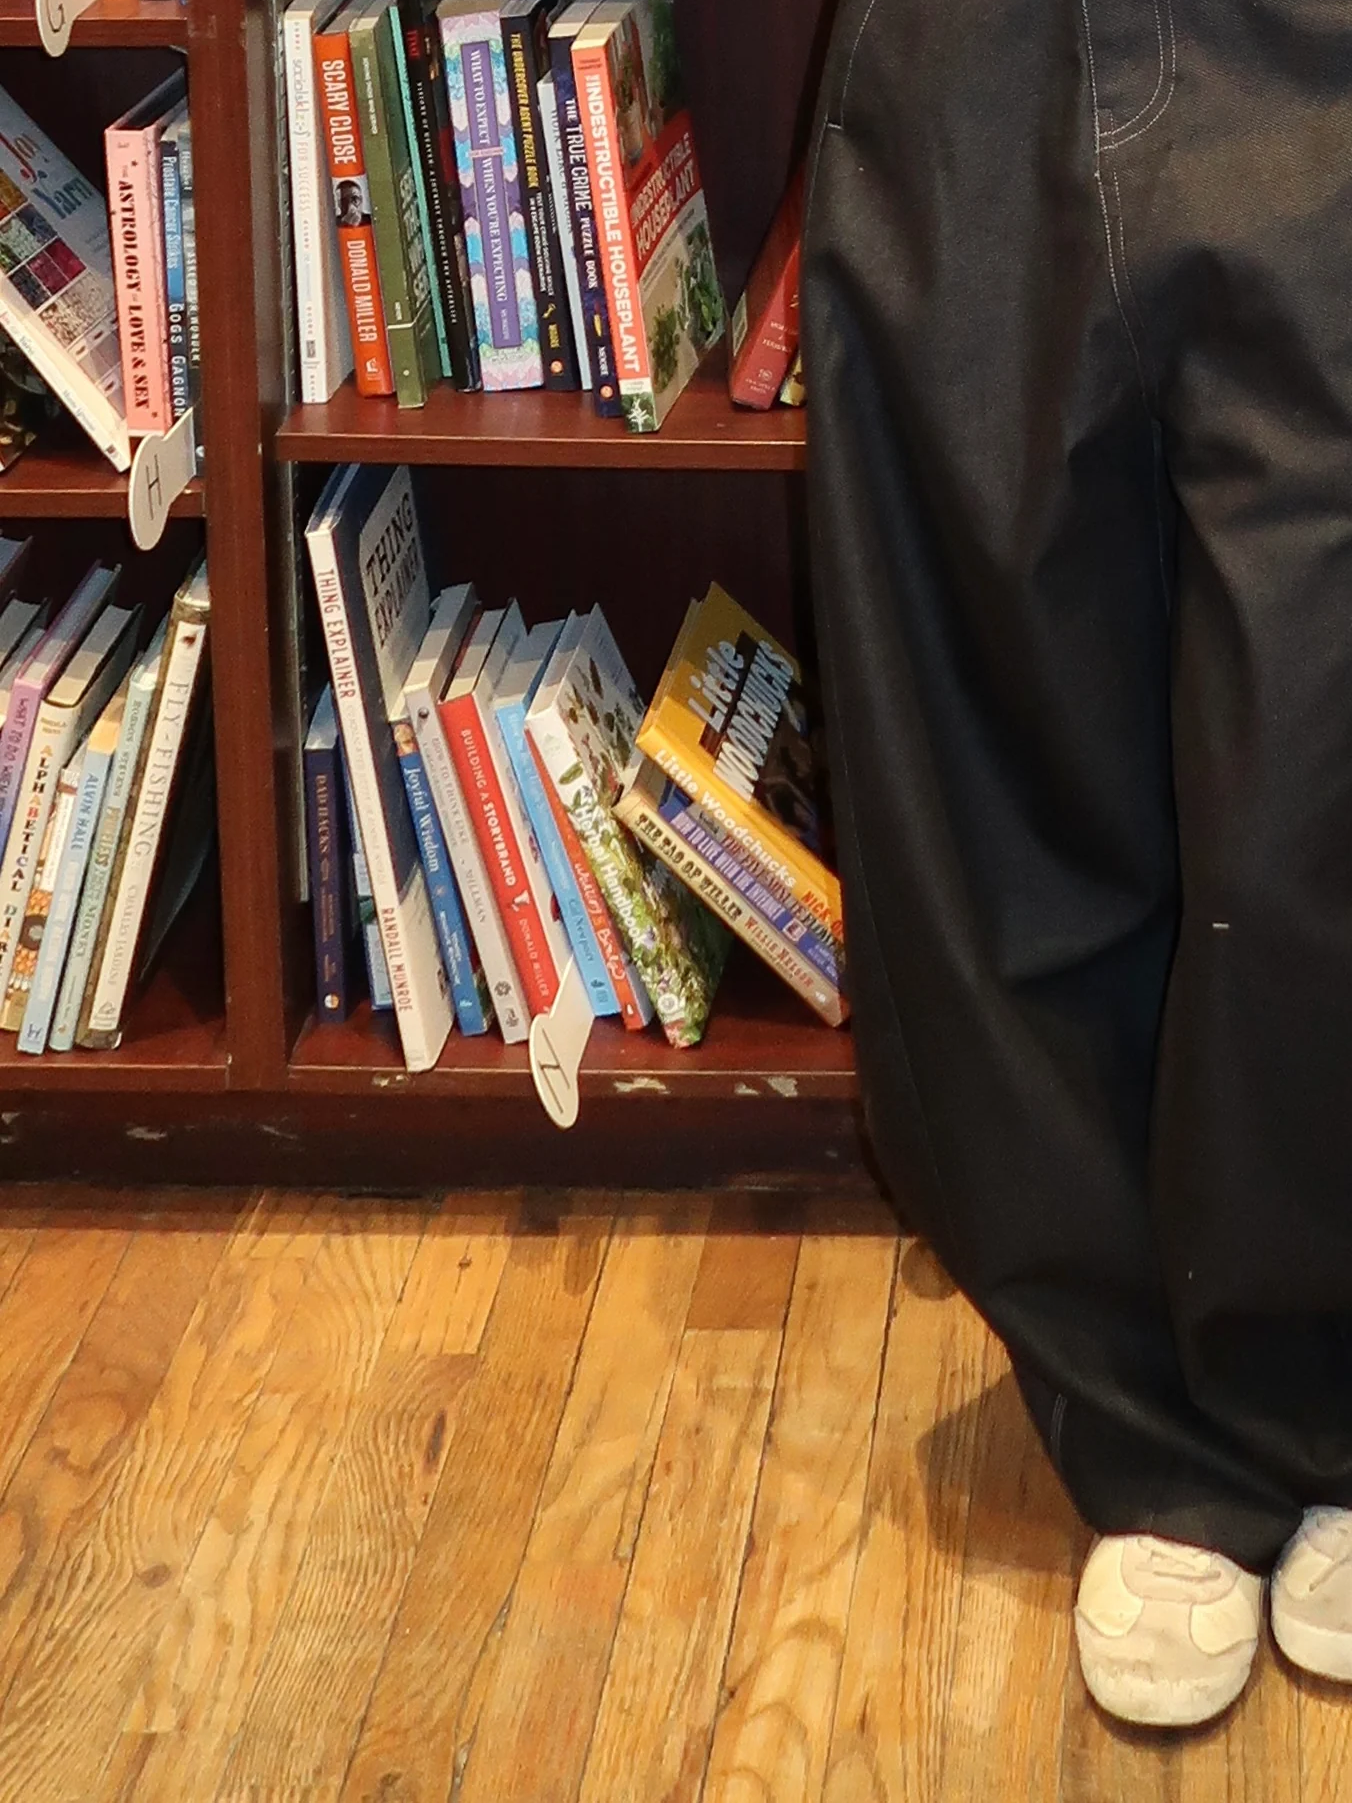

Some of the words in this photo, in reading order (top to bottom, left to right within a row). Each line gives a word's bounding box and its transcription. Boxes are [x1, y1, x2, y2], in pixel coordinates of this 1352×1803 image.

[322, 60, 349, 111] SCARY
[330, 116, 355, 164] CLOSE
[119, 180, 141, 292] ASTROLOGY
[585, 81, 622, 243] INDESTRUCTIBLE
[608, 246, 640, 372] HOUSEPLANT
[346, 241, 369, 292] DONALD
[129, 305, 145, 352] LOVE
[355, 296, 376, 342] MILLER
[132, 357, 146, 369] &
[134, 375, 148, 409] SEX
[317, 569, 341, 616] THING
[326, 620, 356, 699] EXPLAINER
[381, 907, 405, 958] RANDALL
[387, 963, 412, 1013] MUNROE
